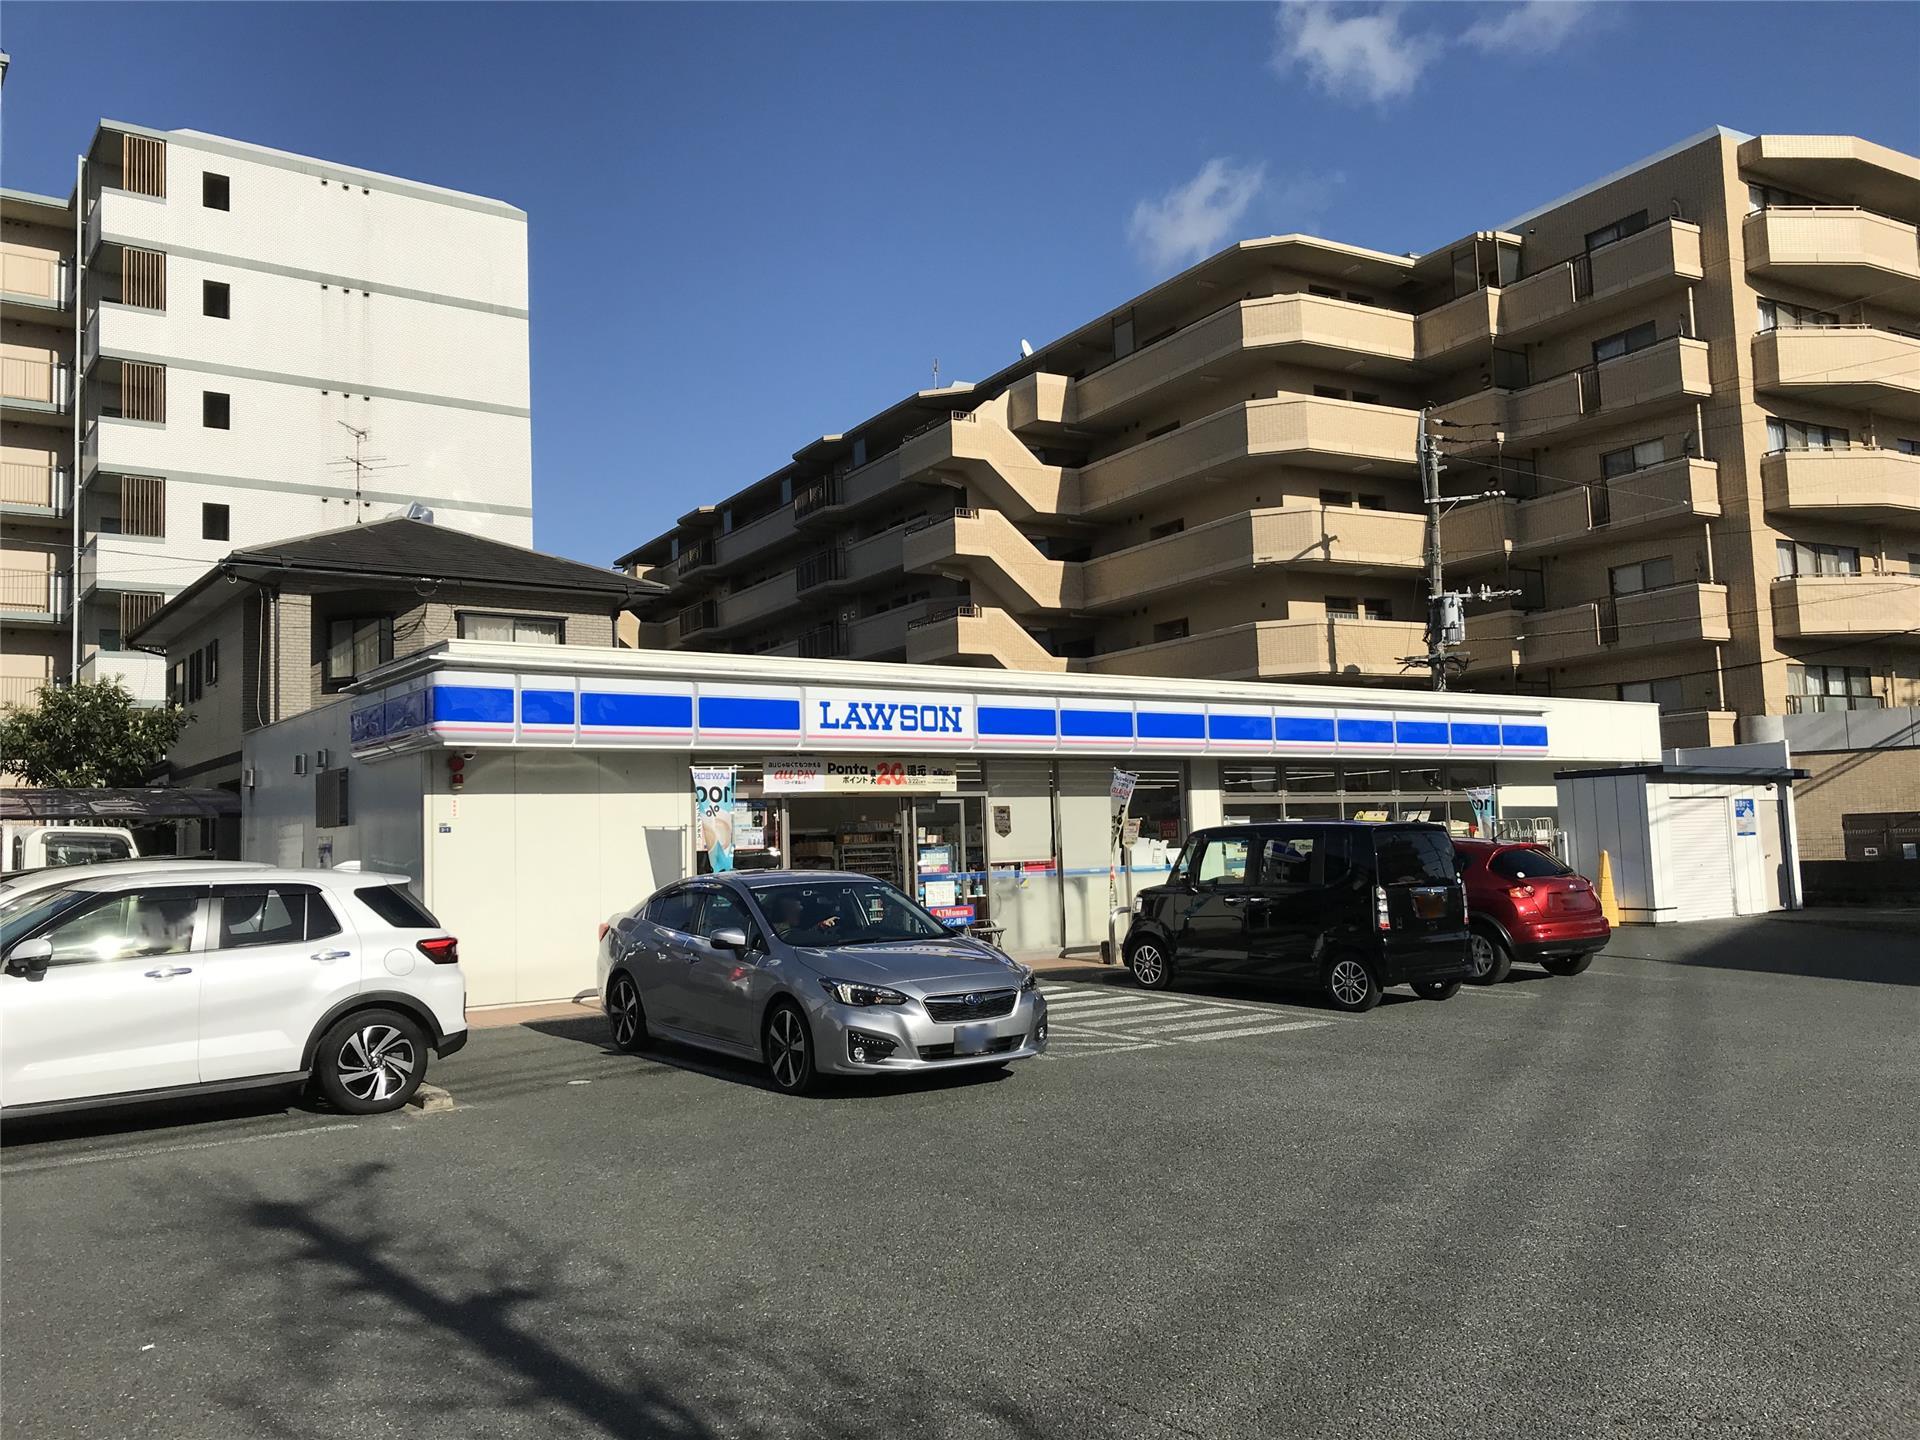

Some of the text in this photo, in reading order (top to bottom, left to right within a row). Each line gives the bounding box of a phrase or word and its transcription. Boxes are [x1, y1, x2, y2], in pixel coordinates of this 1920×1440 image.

[819, 701, 962, 732] LAWSON
[827, 762, 868, 775] Ponta
[774, 769, 816, 780] au PAY
[842, 775, 868, 784] ポイント
[936, 909, 952, 918] ATM
